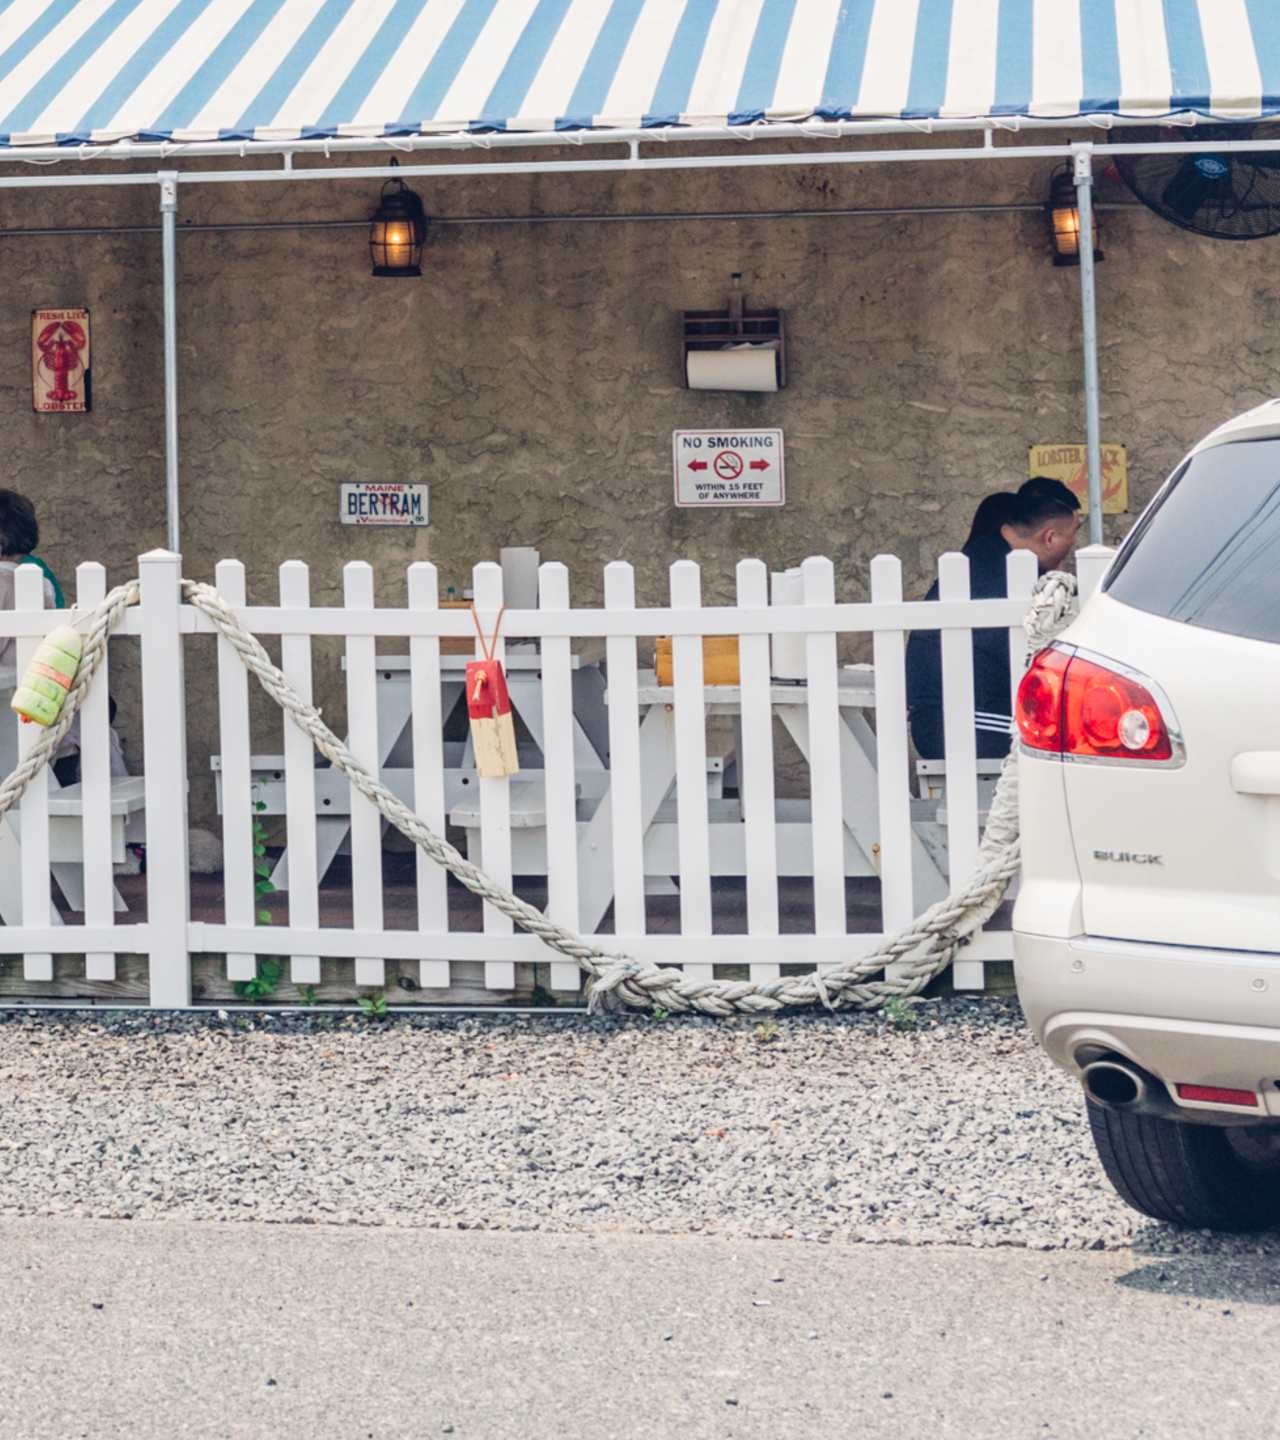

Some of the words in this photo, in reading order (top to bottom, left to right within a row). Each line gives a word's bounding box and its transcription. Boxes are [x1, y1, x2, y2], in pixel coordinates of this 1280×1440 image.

[683, 437, 702, 448] NO
[707, 436, 774, 448] SMOKING
[364, 484, 405, 492] MAINE
[695, 483, 726, 491] WITHIN
[729, 483, 740, 491] 15
[743, 482, 764, 491] FEET
[698, 492, 710, 500] OF
[713, 491, 761, 499] ANYWHERE
[347, 492, 422, 516] BERTRAM
[1093, 850, 1164, 865] BUICK
